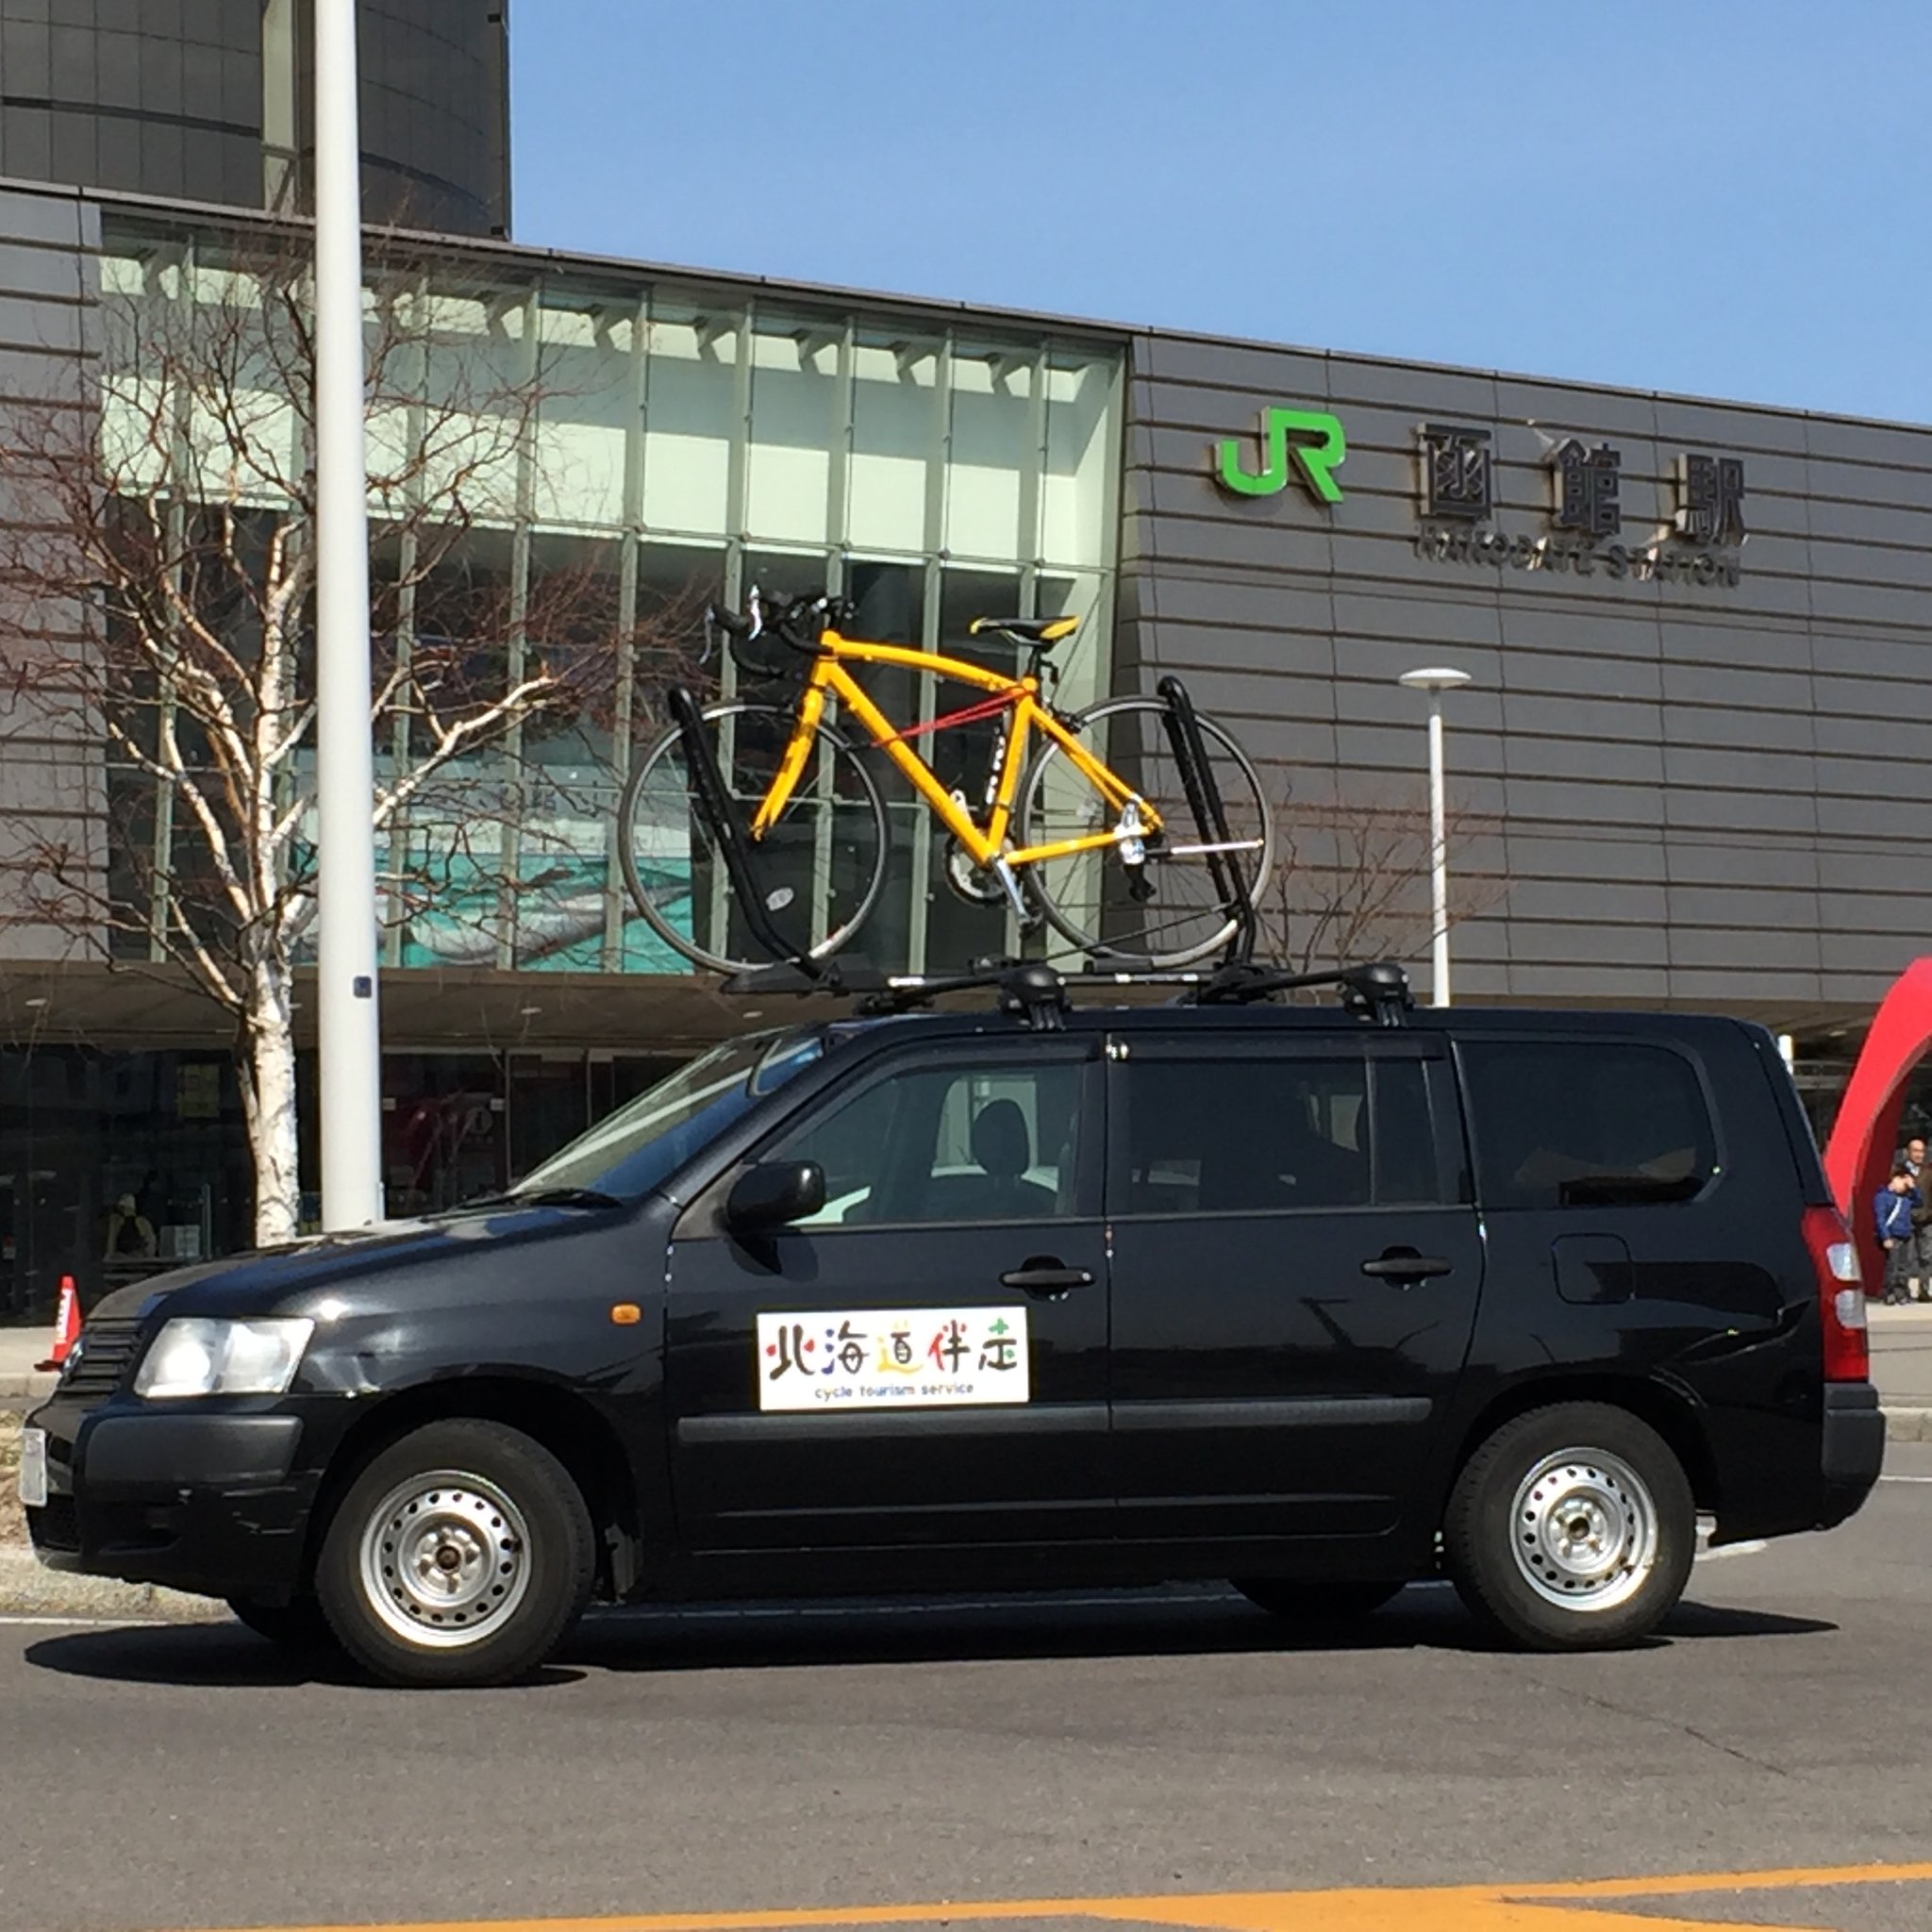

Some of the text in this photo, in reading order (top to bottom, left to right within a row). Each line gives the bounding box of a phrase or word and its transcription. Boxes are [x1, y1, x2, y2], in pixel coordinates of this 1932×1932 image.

[1216, 407, 1345, 502] JR
[1418, 422, 1745, 547] 函館駅
[814, 1382, 974, 1402] cycle tourism service
